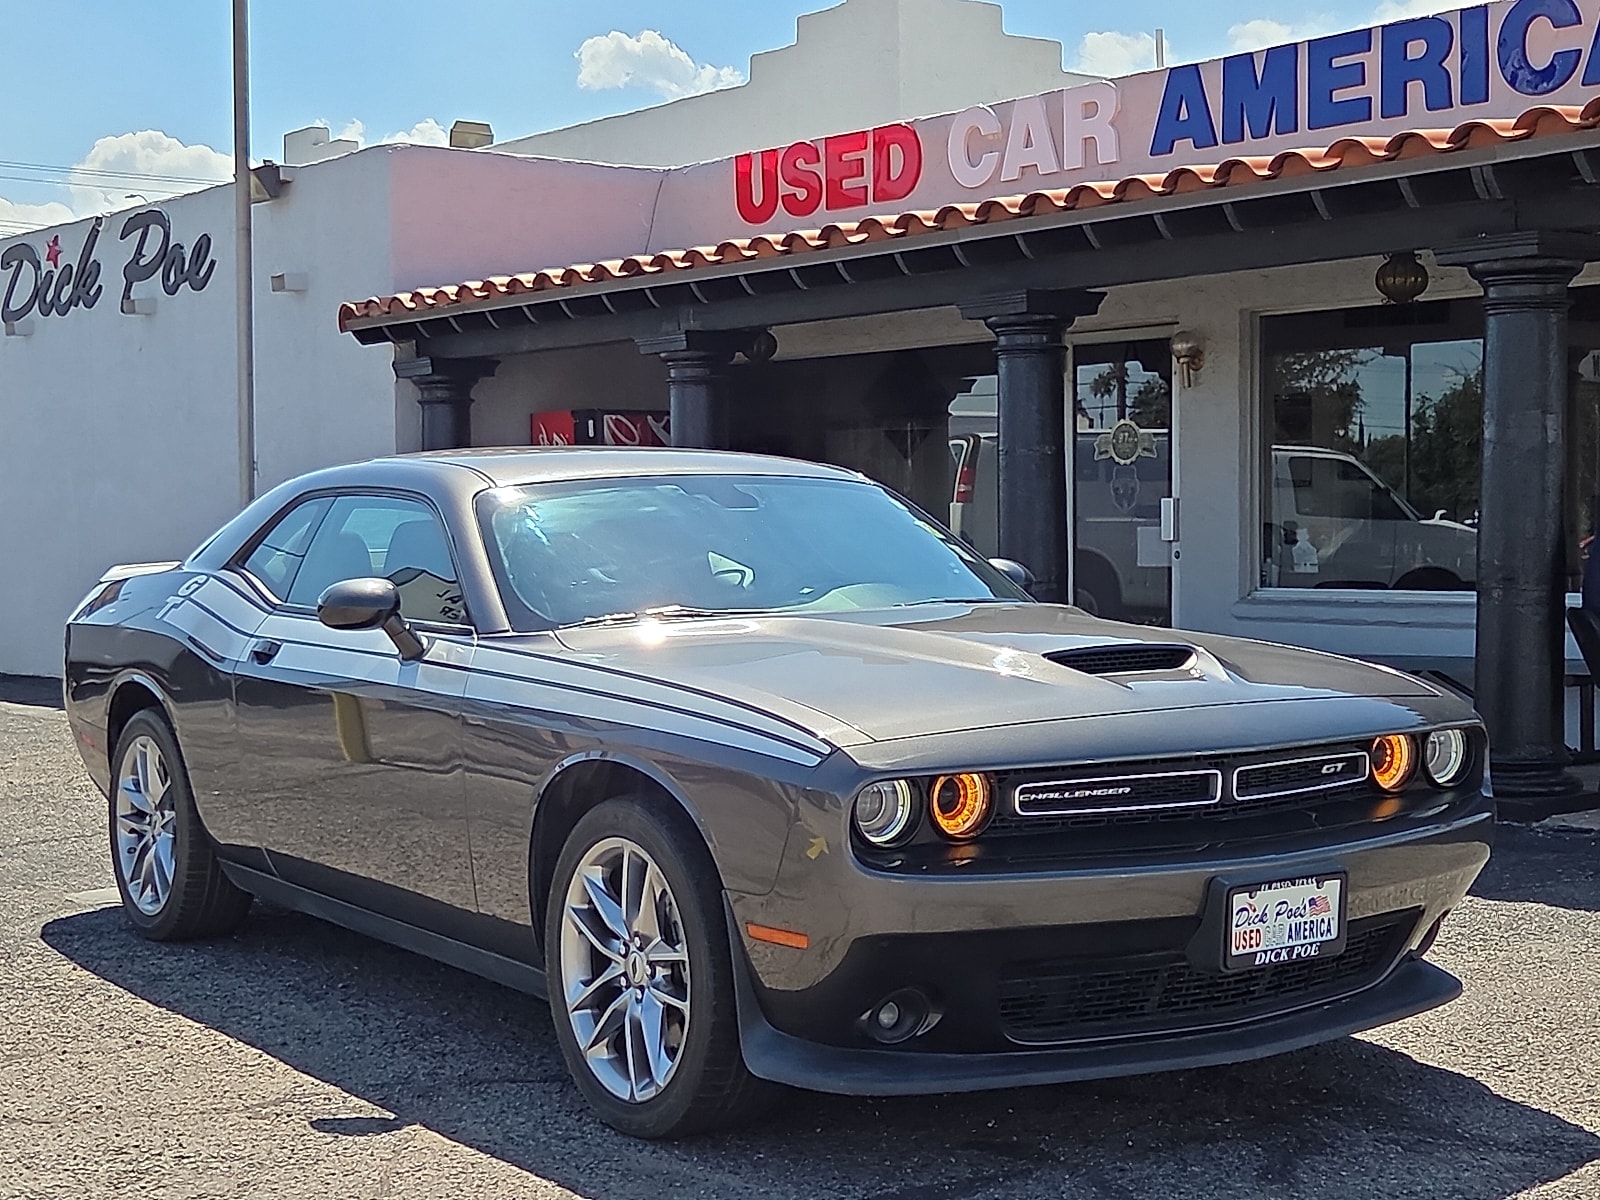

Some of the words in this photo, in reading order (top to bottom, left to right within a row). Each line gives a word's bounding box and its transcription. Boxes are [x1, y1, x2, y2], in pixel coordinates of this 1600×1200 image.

[734, 122, 923, 225] USED
[947, 79, 1120, 188] CAR
[0, 216, 103, 324] Dick
[118, 208, 217, 314] Poe
[1320, 762, 1347, 774] GT
[1019, 786, 1131, 801] CHALLENGER
[1235, 902, 1269, 929] Dick
[1274, 897, 1307, 923] Poe's
[1234, 928, 1262, 951] USED
[1287, 917, 1333, 943] AMERICA
[1255, 947, 1290, 966] DICK
[1292, 942, 1321, 960] POE
